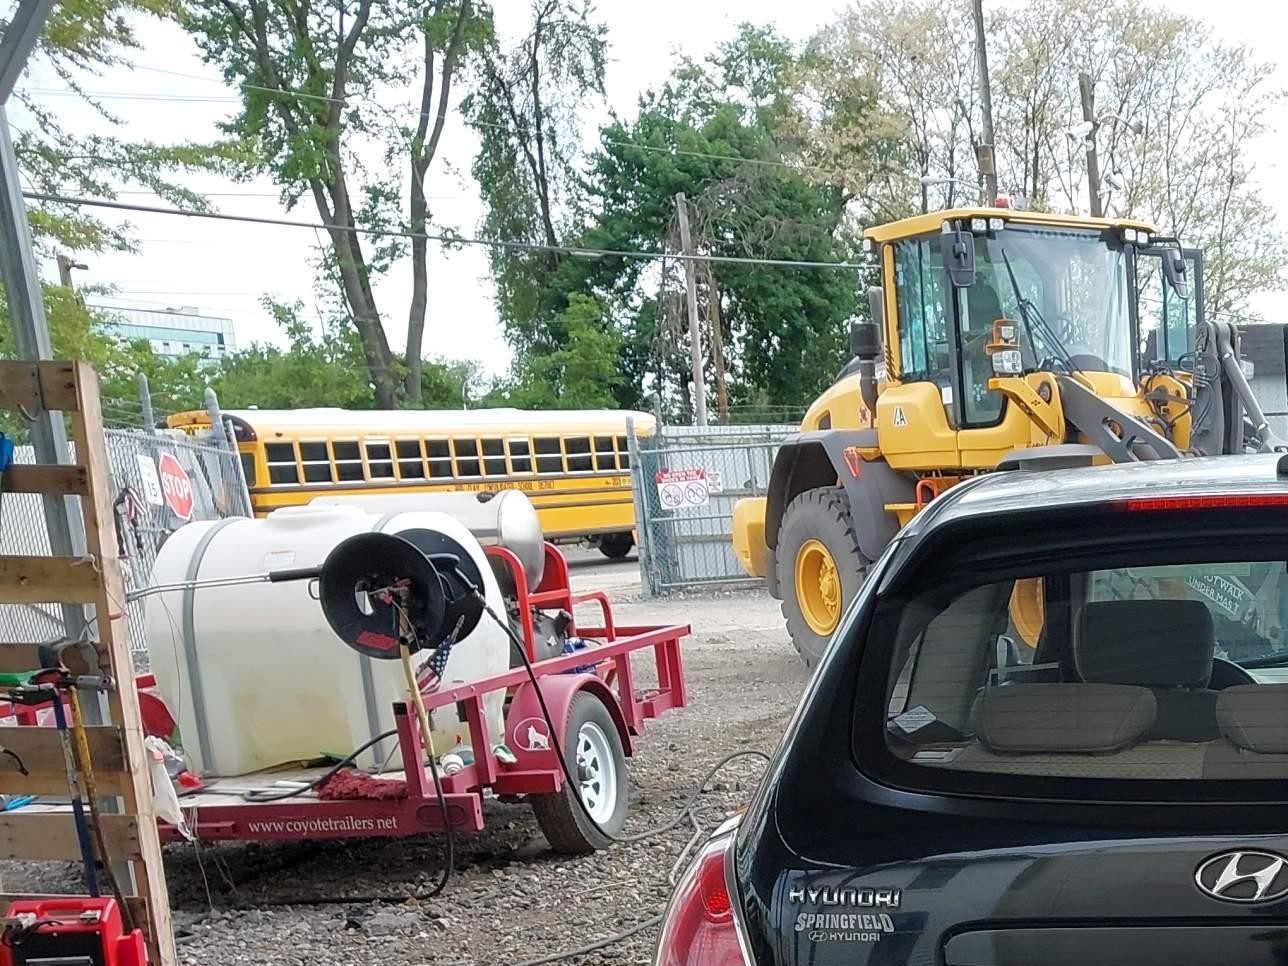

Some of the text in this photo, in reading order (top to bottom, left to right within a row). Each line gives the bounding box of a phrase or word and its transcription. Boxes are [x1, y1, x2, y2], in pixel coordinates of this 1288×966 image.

[147, 481, 158, 497] 15
[162, 472, 189, 500] STOP
[1188, 575, 1216, 598] UNDER
[1219, 578, 1244, 601] WALK
[789, 886, 901, 908] HYUNDAI
[794, 912, 896, 933] SPRINGFIELD
[829, 932, 882, 942] HYUNDAI
